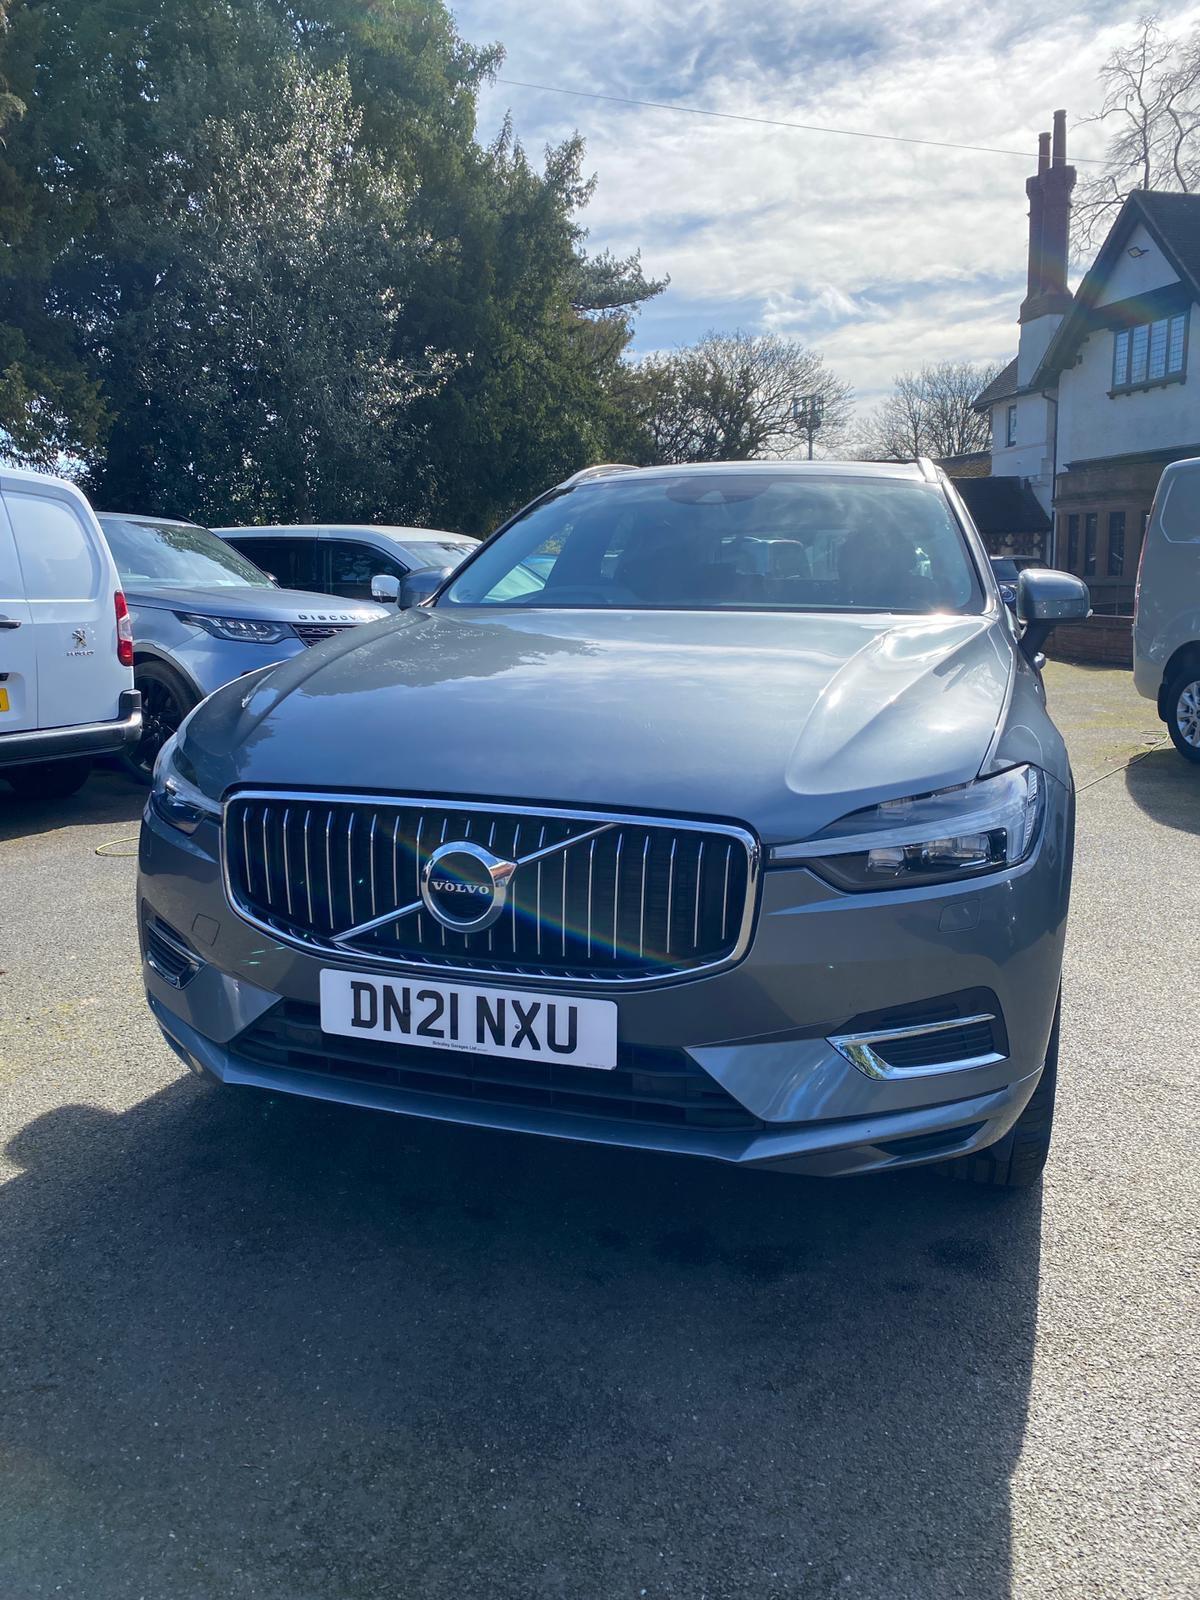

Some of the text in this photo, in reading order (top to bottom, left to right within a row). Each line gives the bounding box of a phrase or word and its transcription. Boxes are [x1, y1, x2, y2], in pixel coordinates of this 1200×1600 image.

[432, 881, 489, 894] VOLVO
[350, 980, 578, 1054] DN21 NXU
